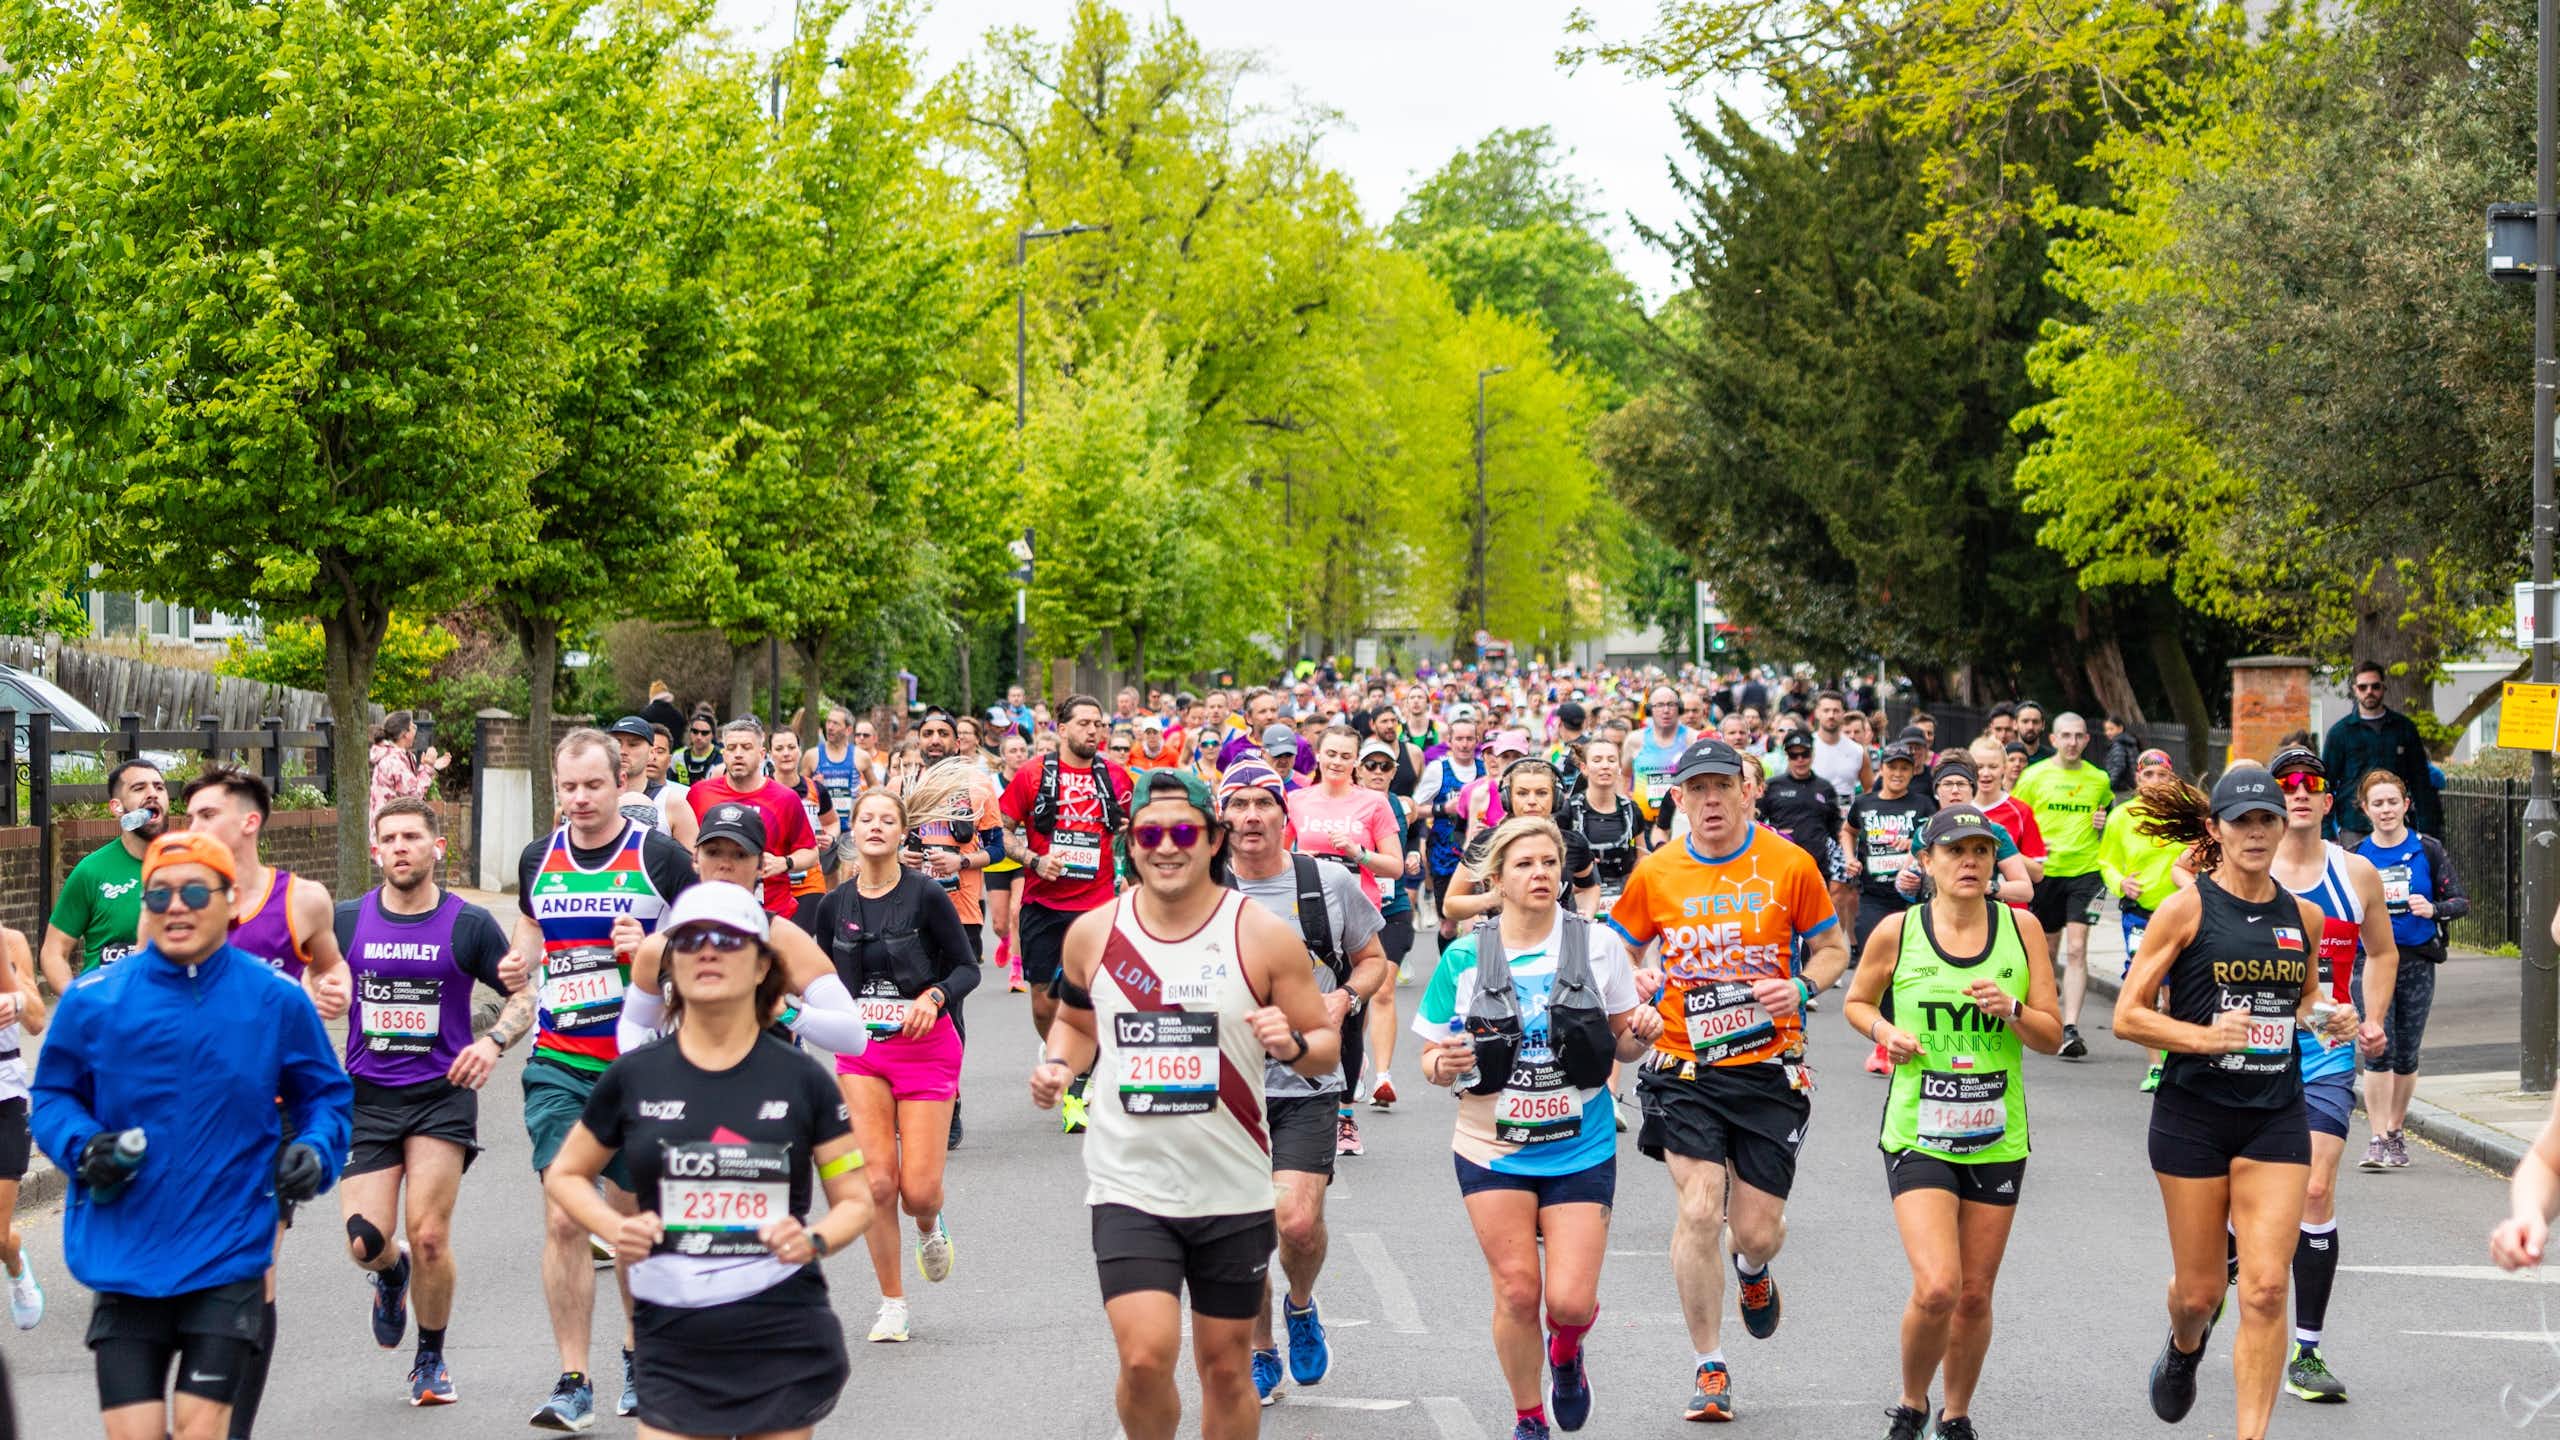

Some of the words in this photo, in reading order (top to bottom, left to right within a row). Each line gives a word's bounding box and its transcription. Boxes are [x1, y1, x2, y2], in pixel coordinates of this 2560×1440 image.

[1864, 814, 1915, 832] SANDRA
[1954, 814, 1981, 825] TYM
[1053, 830, 1073, 845] tcs
[541, 897, 635, 913] ANDREW
[1683, 893, 1764, 917] STEVE
[363, 942, 441, 961] MACAWLEY
[549, 956, 572, 975] tcs
[1201, 963, 1227, 980] 24
[2212, 959, 2306, 983] ROSARIO
[365, 980, 392, 1000] tcs
[558, 975, 609, 1004] 25111
[1168, 985, 1208, 999] GEMINI
[2256, 991, 2275, 999] TATA
[1688, 992, 1716, 1012] tcs
[2220, 990, 2253, 1010] tcs
[860, 1003, 905, 1022] 24025
[1918, 1001, 2008, 1033] TYM
[2253, 1005, 2281, 1014] SERVICES
[372, 1009, 427, 1030] 18366
[576, 1017, 591, 1025] new
[591, 1011, 621, 1023] balance
[1157, 1017, 1182, 1026] TATA
[1699, 1007, 1756, 1038] 20267
[1118, 1018, 1156, 1043] tcs
[1157, 1025, 1213, 1035] CONSULTANCY
[1157, 1034, 1193, 1043] SERVICES
[1729, 1046, 1744, 1057] new
[1744, 1036, 1773, 1051] balance
[1919, 1033, 2003, 1053] RUNNING
[388, 1044, 404, 1052] new
[404, 1043, 432, 1052] balance
[1130, 1055, 1202, 1081] 21669
[1534, 1066, 1554, 1075] TATA
[2244, 1063, 2259, 1071] new
[2259, 1062, 2287, 1073] balance
[1534, 1078, 1563, 1088] SERVICES
[1925, 1074, 1958, 1098] tcs
[1959, 1077, 1980, 1085] TATA
[1959, 1082, 2004, 1092] CONSULTANCY
[1959, 1090, 1989, 1099] SERVICES
[1152, 1103, 1172, 1112] new
[1172, 1101, 1209, 1112] balance
[1509, 1095, 1571, 1119] 20566
[1529, 1134, 1546, 1143] new
[1546, 1129, 1574, 1142] balance
[718, 1148, 748, 1159] TATA
[669, 1147, 716, 1178] tcs
[718, 1158, 783, 1170] CONSULTANCY
[718, 1169, 760, 1179] SERVICES
[683, 1191, 769, 1220] 23768
[710, 1244, 733, 1255] new
